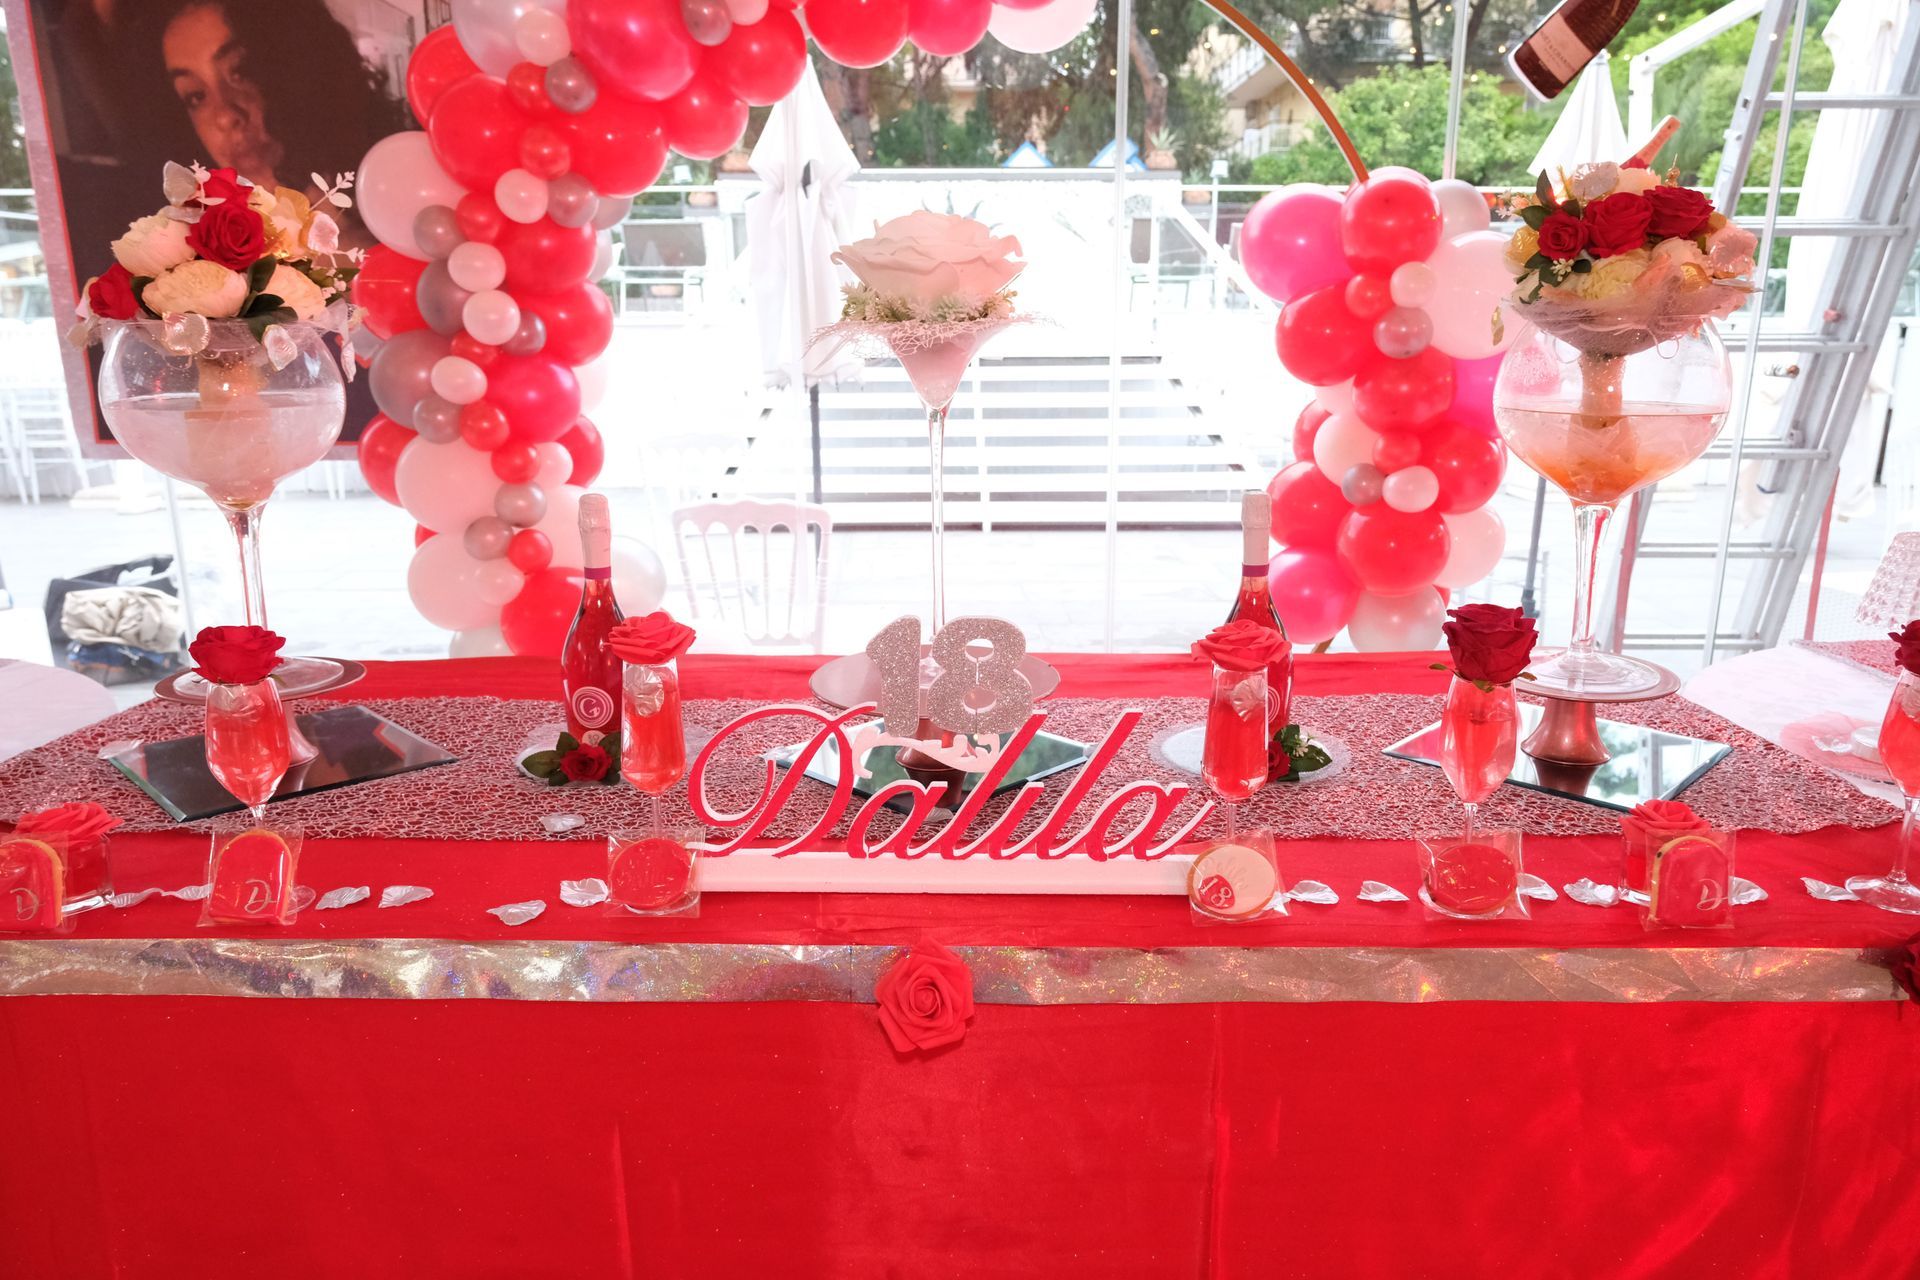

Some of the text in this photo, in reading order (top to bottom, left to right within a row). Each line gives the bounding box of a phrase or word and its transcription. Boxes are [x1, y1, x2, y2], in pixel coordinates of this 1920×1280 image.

[865, 615, 1032, 735] 18
[687, 701, 1215, 861] Dalila
[1199, 877, 1232, 907] 18
